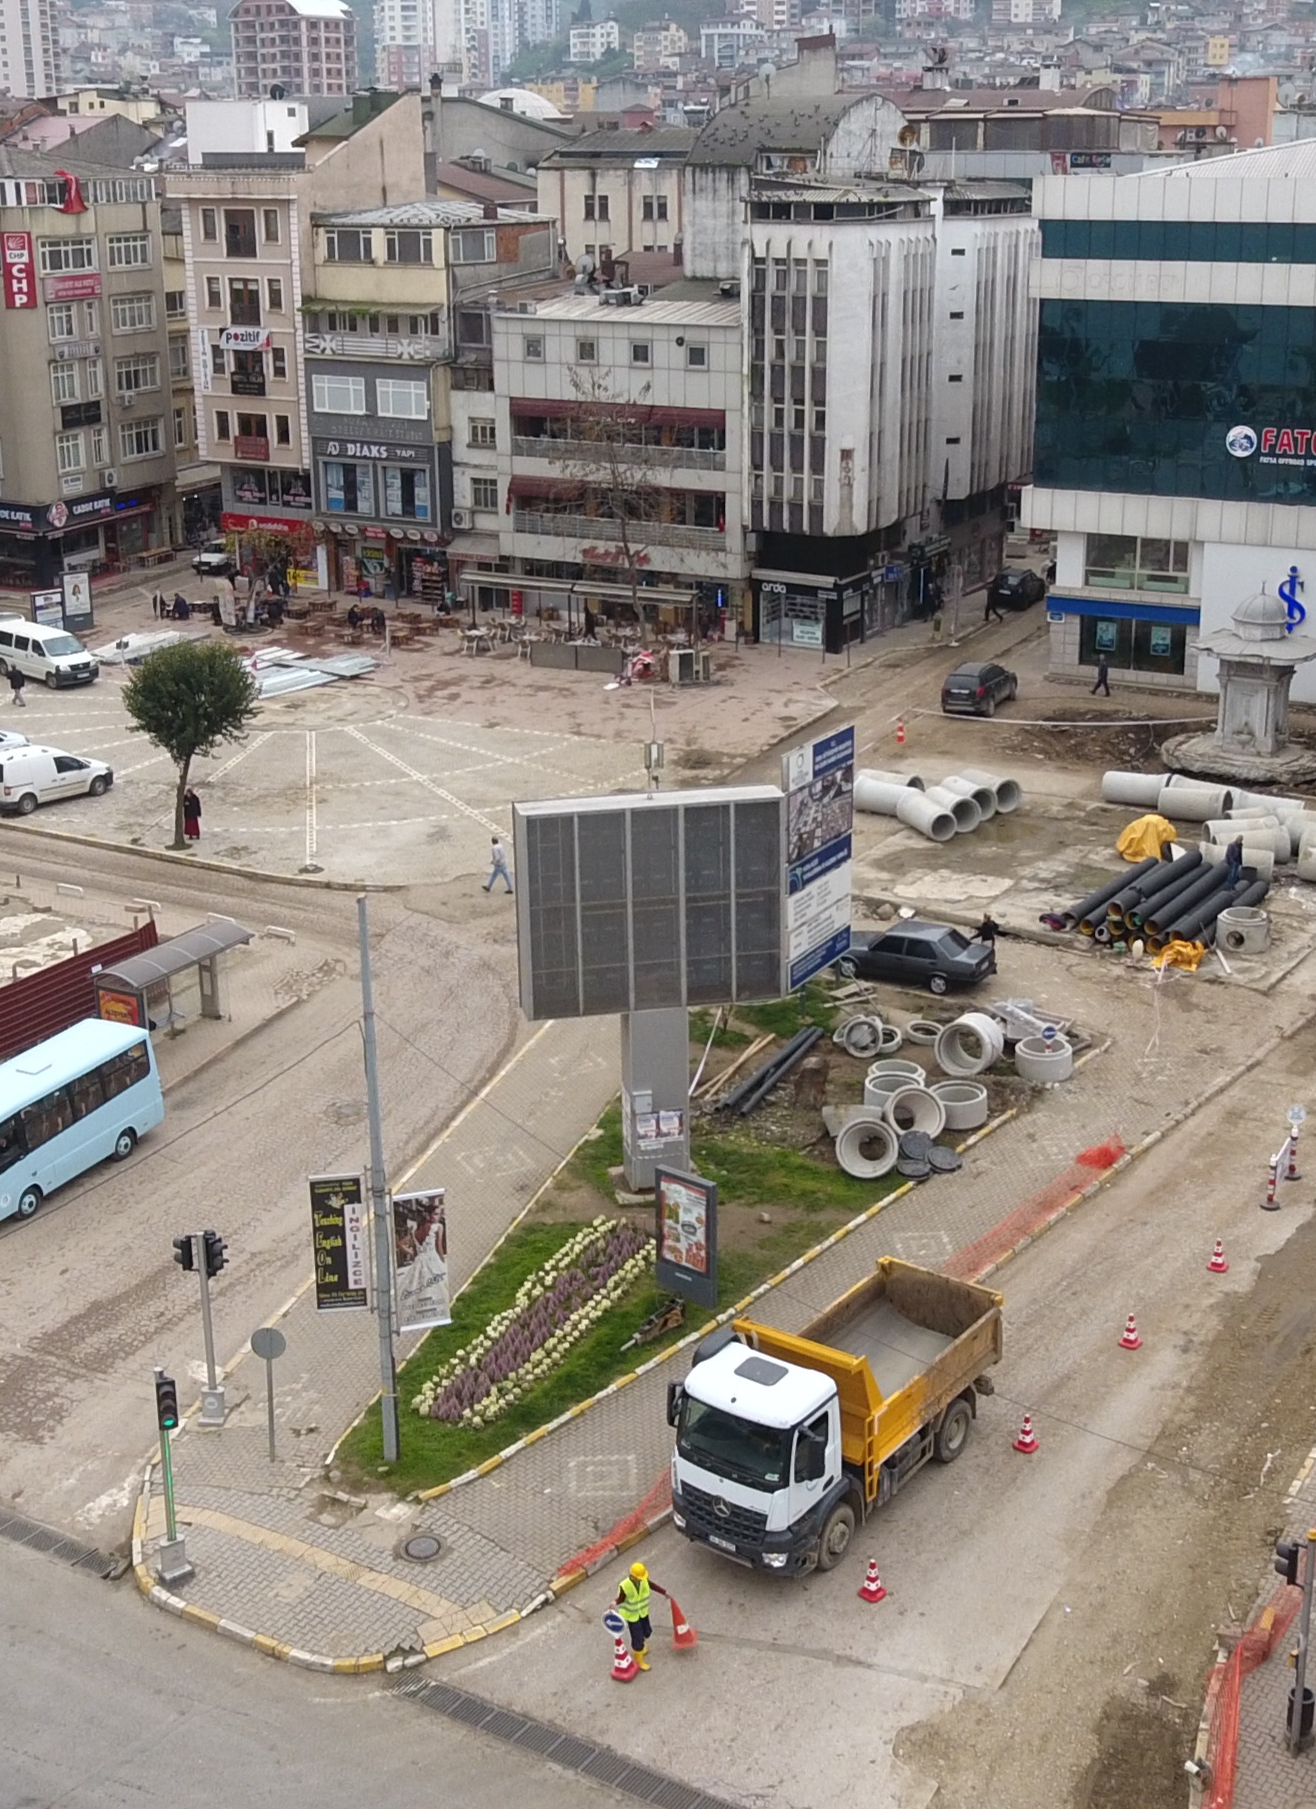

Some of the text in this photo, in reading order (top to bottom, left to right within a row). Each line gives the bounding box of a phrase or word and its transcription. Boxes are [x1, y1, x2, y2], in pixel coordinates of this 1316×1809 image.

[11, 264, 28, 308] CHP
[226, 331, 260, 344] pozitif
[762, 582, 787, 594] arda
[316, 1232, 343, 1250] English
[317, 1250, 332, 1266] On
